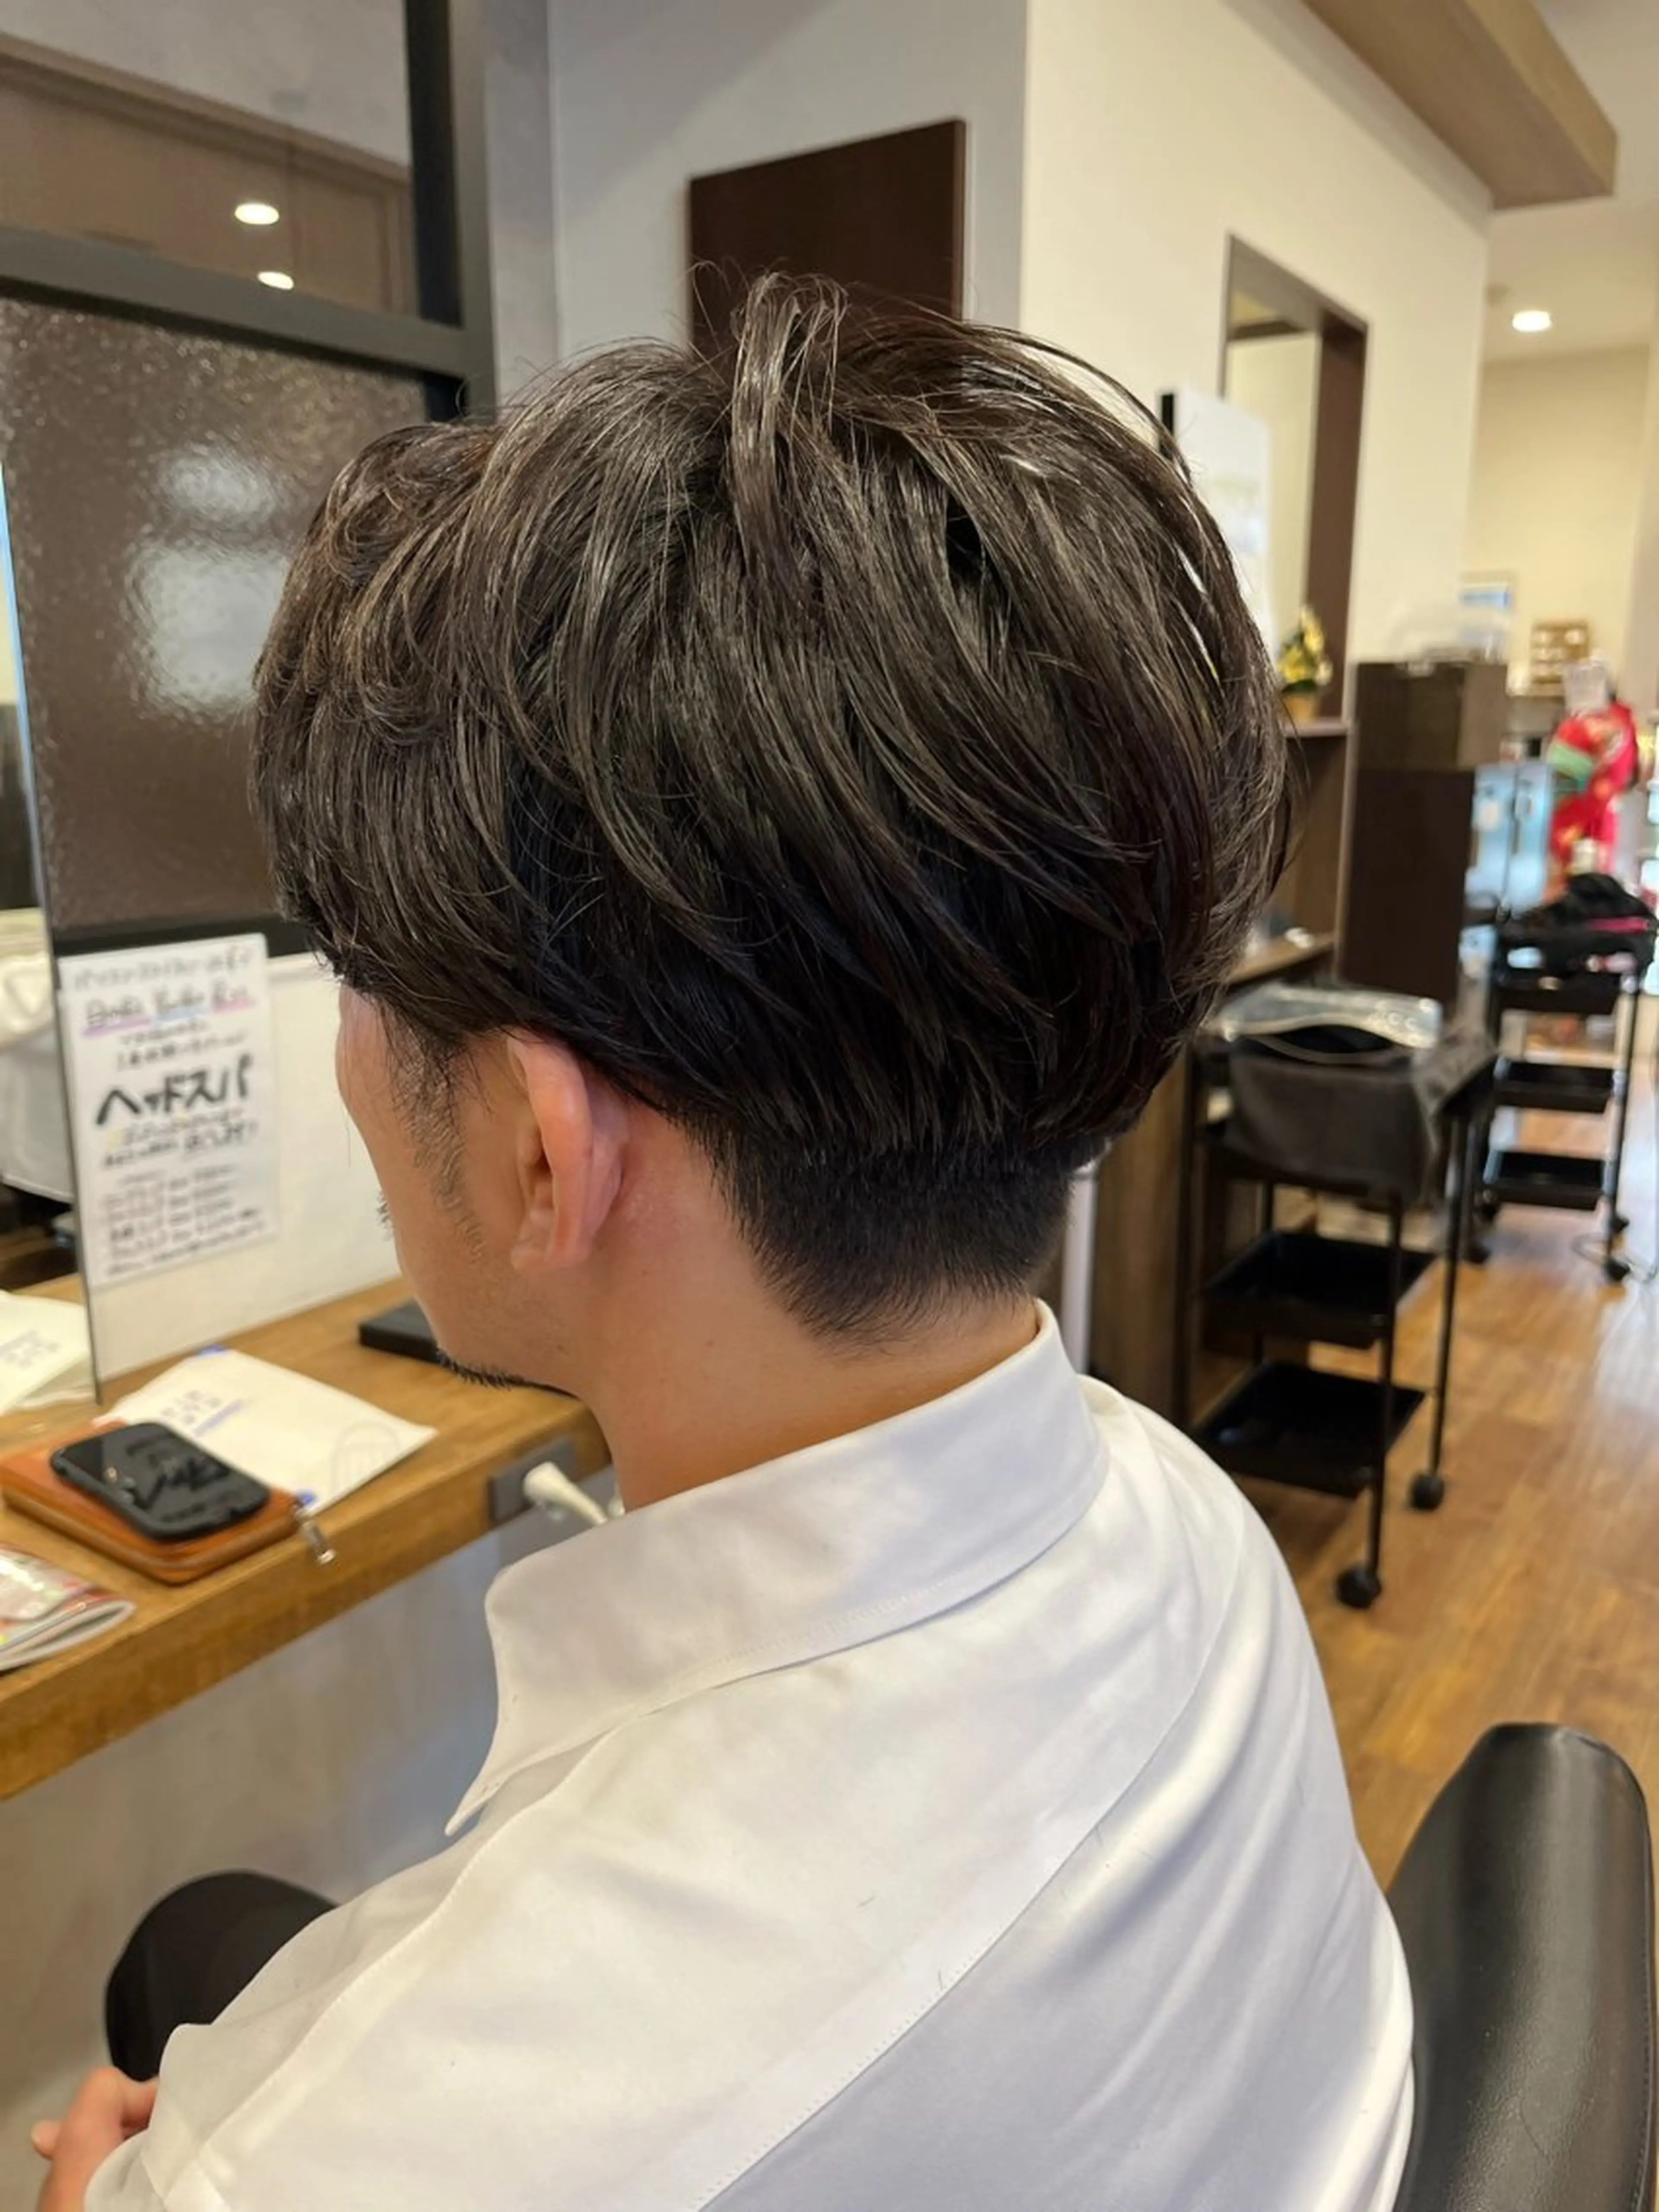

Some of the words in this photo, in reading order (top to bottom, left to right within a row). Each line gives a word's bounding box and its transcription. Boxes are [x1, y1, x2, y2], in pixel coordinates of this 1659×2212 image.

[96, 1054, 253, 1126] ヘッドスパ
